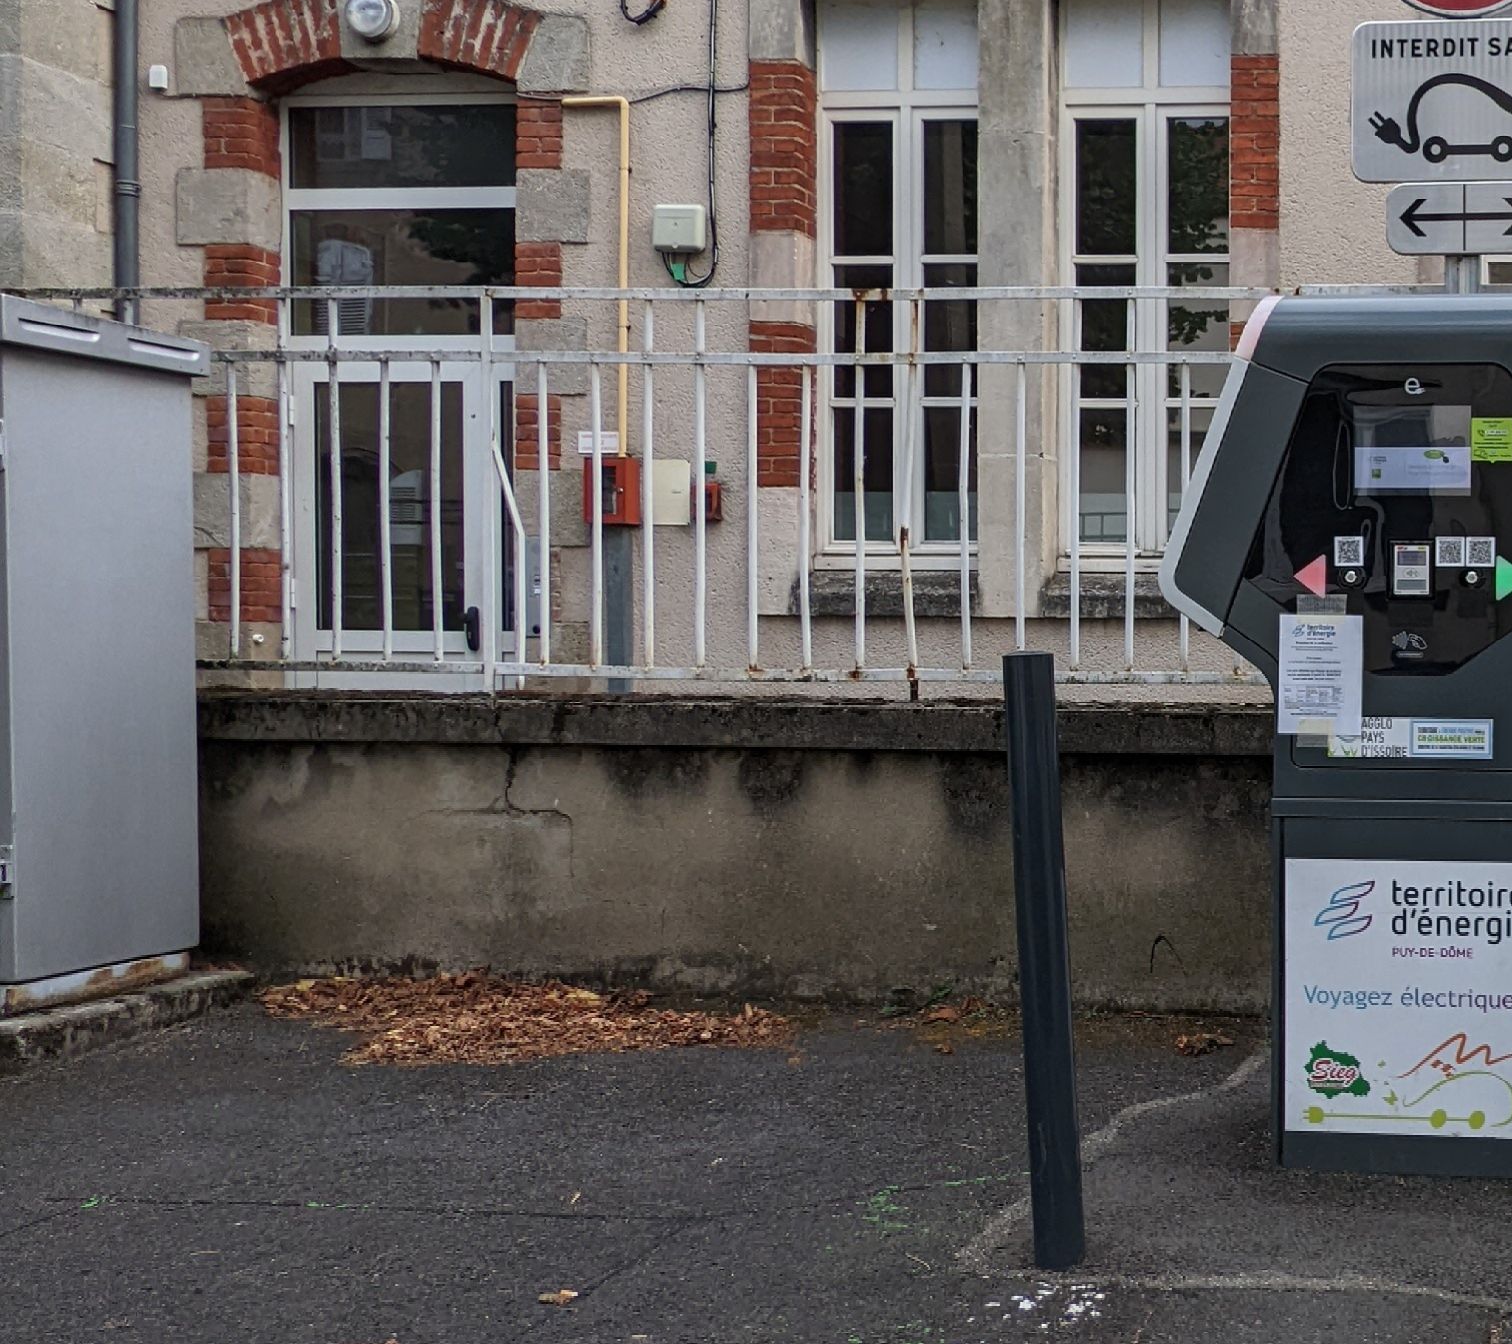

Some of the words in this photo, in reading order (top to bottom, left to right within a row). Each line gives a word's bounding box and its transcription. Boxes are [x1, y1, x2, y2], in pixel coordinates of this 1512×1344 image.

[1371, 37, 1479, 59] INTERDIT
[1361, 717, 1393, 730] AGGLO
[1361, 731, 1385, 744] PAYS
[1361, 745, 1408, 758] D'ISSOIRE
[1391, 945, 1474, 959] PUY-DE-DÔME
[1303, 984, 1393, 1010] Voyagez
